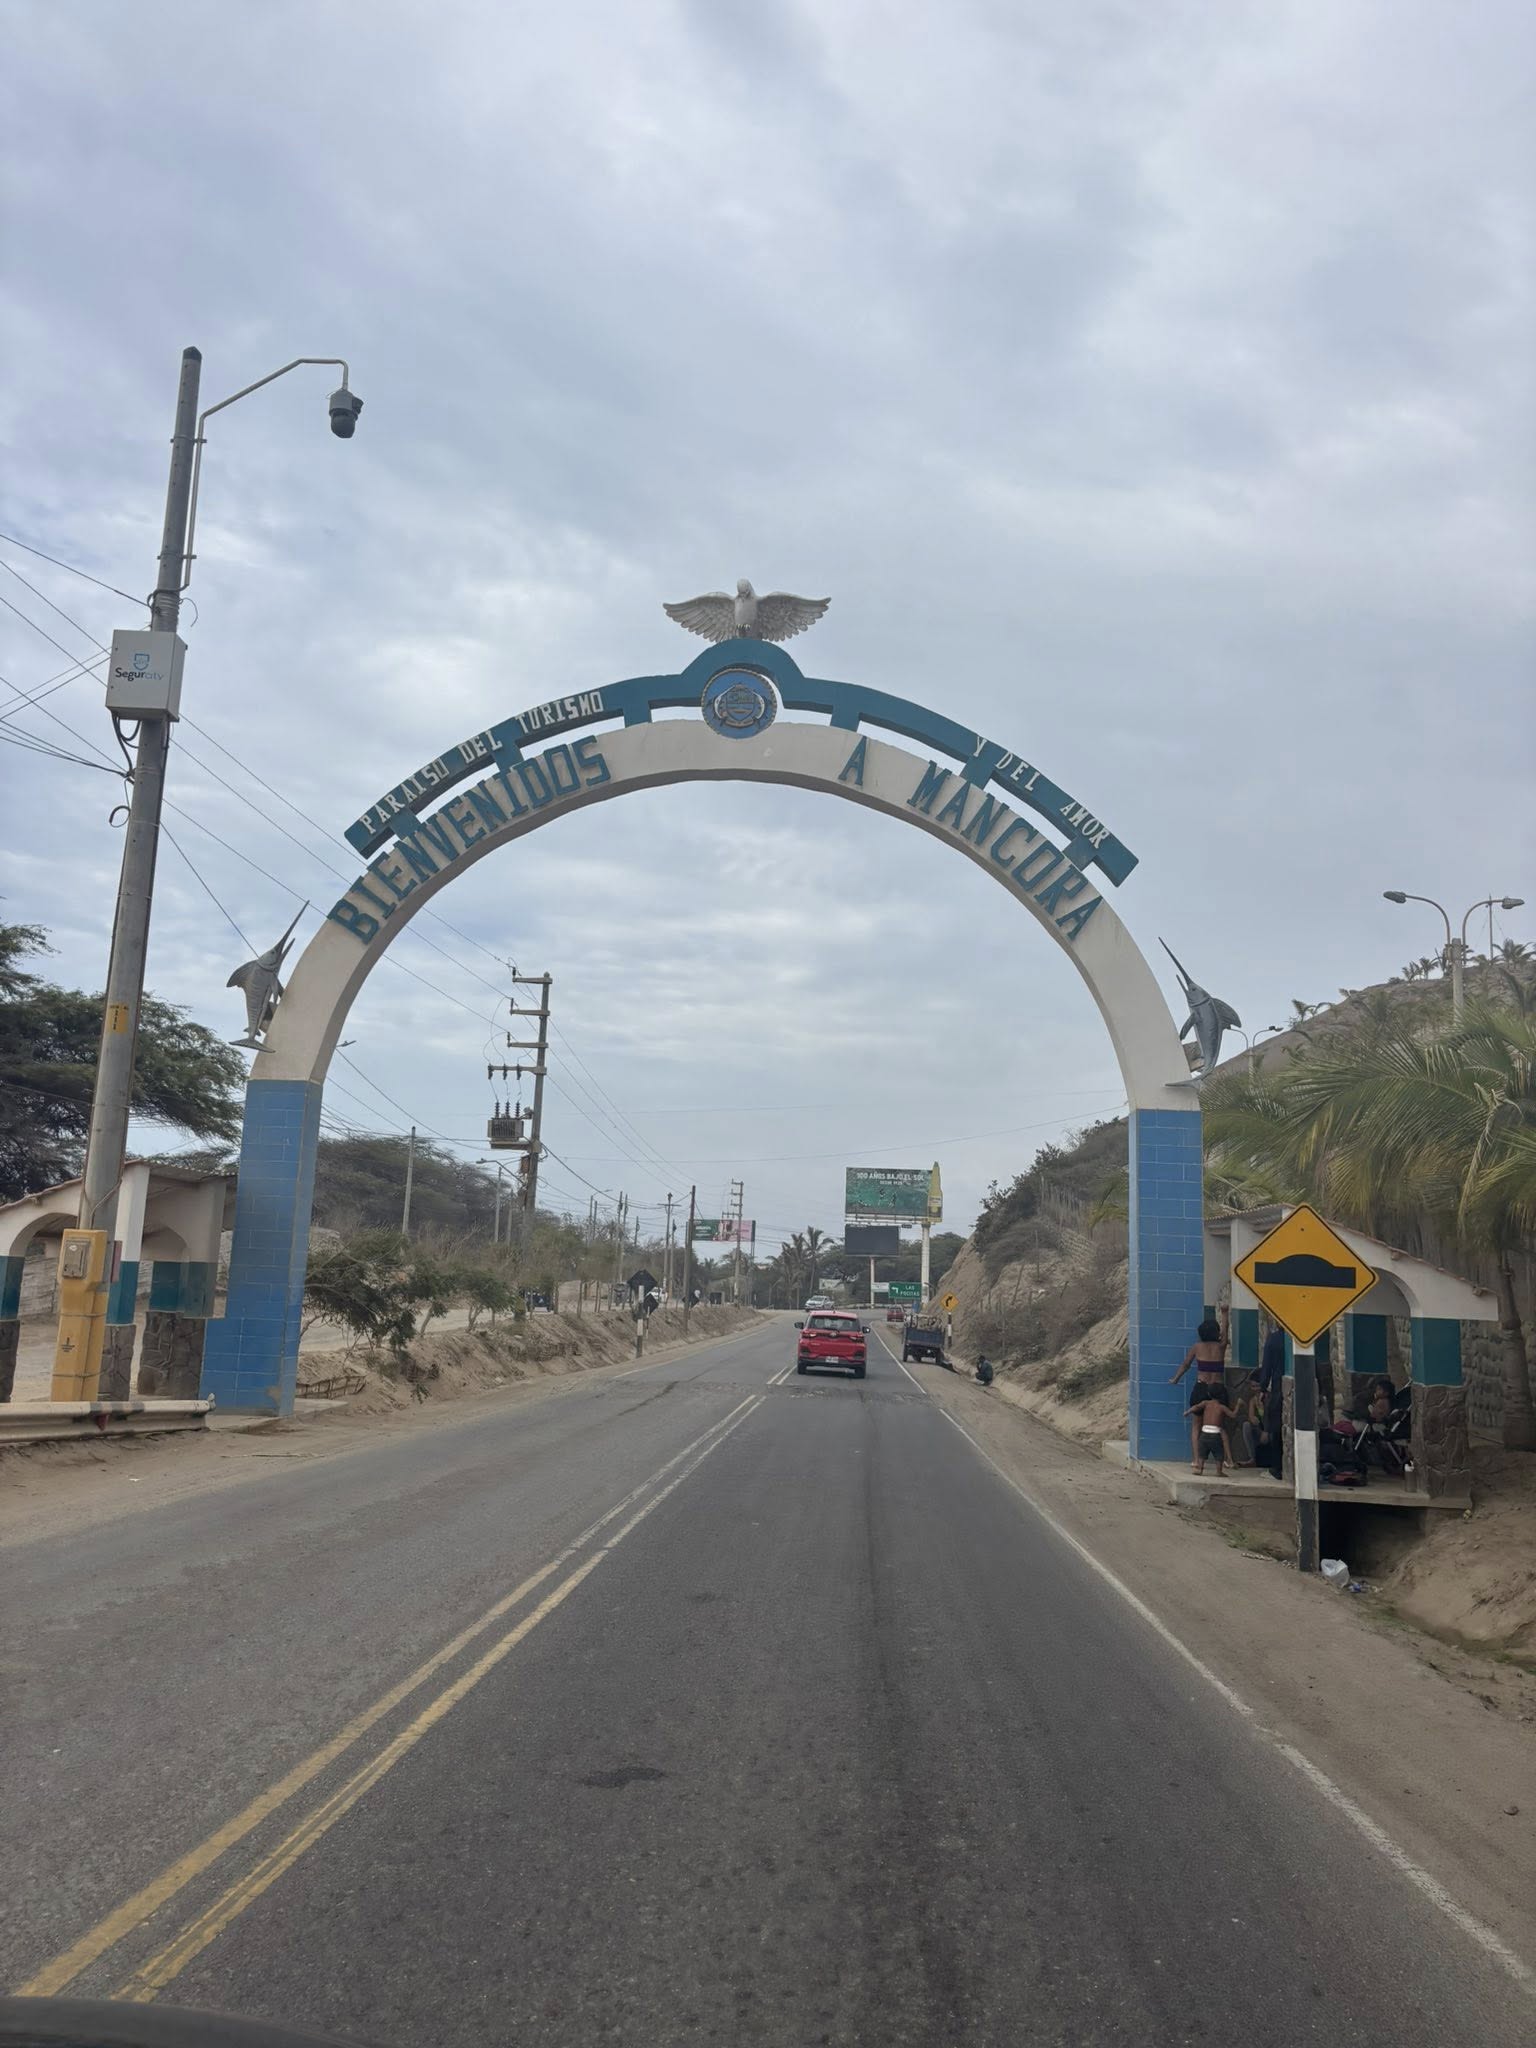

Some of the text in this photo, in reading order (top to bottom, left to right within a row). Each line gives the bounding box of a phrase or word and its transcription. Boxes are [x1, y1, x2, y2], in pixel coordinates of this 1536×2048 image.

[326, 734, 1104, 946] BIENVENIDOS A MANCORA
[359, 690, 1110, 850] PARAISO DEL TURISMO Y DEL AMOR
